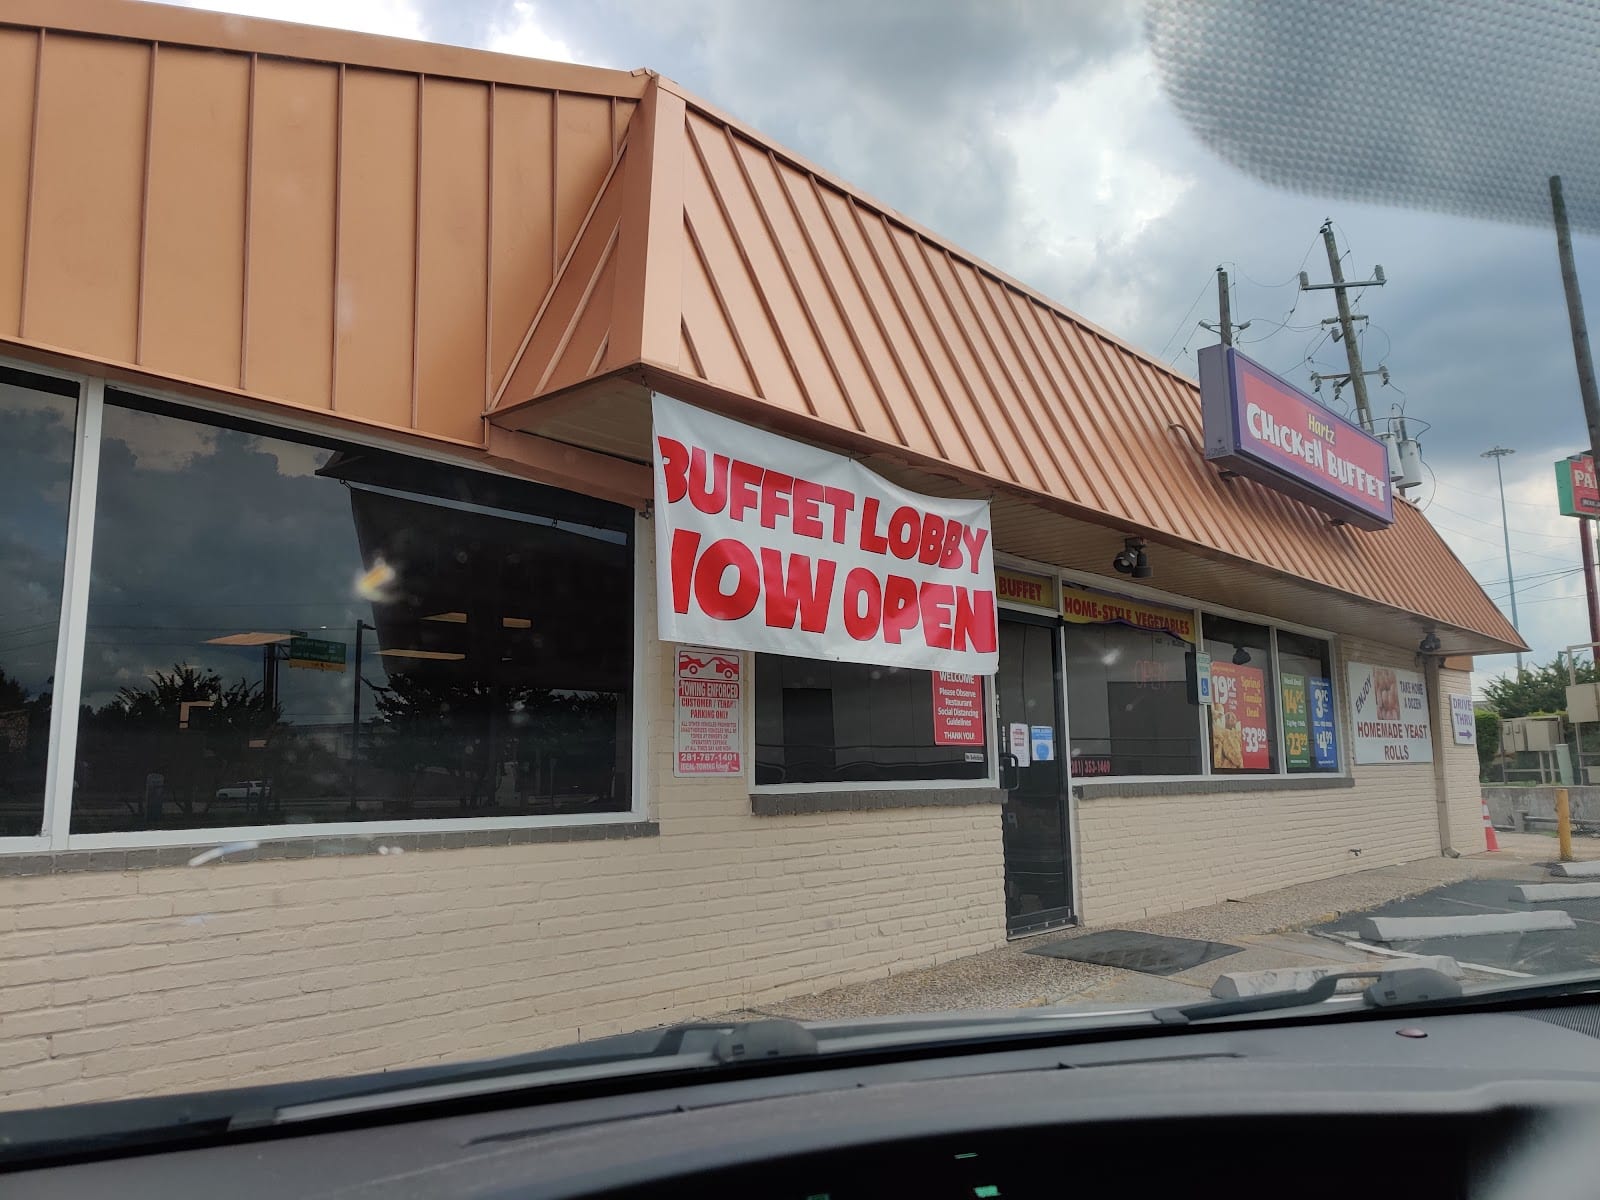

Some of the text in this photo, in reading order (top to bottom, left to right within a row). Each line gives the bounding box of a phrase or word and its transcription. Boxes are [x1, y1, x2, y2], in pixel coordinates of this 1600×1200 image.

[1307, 413, 1336, 445] Hartz
[1326, 448, 1386, 502] BUFFET
[1574, 469, 1598, 489] PA
[859, 496, 989, 574] LOBBY
[999, 576, 1042, 601] BUFFET
[843, 567, 997, 653] OPEN
[1064, 597, 1189, 635] HOME-STYLE VEGETABLES
[940, 671, 975, 684] WELCOME
[680, 681, 738, 699] TOWING ENFORCED
[939, 687, 977, 698] Please Observe
[1355, 674, 1372, 713] ENJOY
[1400, 681, 1424, 696] TAKE HOME
[681, 698, 712, 708] CUSTOMER
[1408, 698, 1422, 710] DOZEN
[1452, 698, 1472, 711] DRIVE
[690, 709, 729, 719] PARKING ONLY
[938, 707, 979, 719] Social Distancing
[1454, 713, 1473, 726] THRU
[944, 731, 963, 740] THANK
[1357, 721, 1428, 739] HOMEMADE YEAST
[1384, 745, 1410, 760] ROLLS
